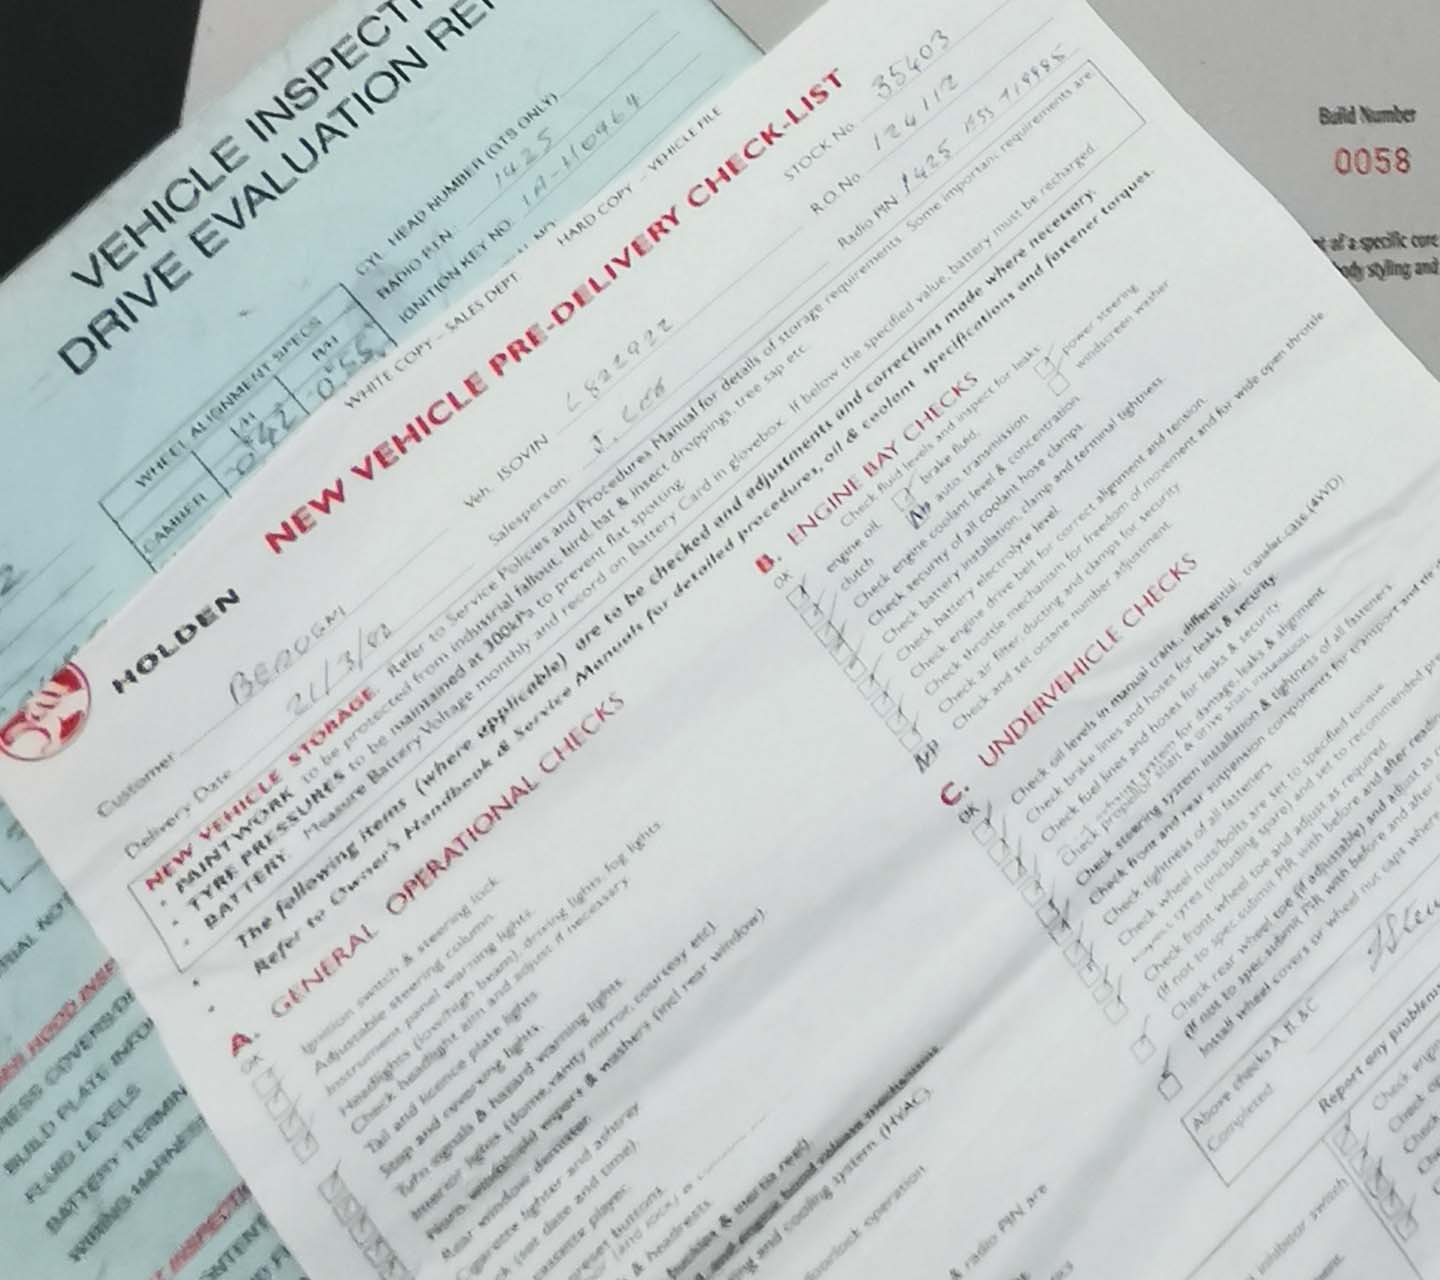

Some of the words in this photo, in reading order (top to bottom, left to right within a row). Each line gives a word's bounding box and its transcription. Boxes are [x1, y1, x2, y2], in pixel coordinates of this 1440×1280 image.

[783, 138, 833, 182] STOCK
[1318, 105, 1357, 126] Build
[1359, 104, 1417, 125] Number
[1334, 146, 1411, 176] 0058
[57, 250, 193, 376] DRIVE
[188, 44, 429, 259] EVALUATION
[70, 135, 249, 289] VEHICLE
[426, 157, 486, 212] NUMBER
[837, 218, 874, 249] Radio
[394, 340, 433, 373] COPY
[556, 213, 597, 246] HARD
[597, 183, 633, 216] COPY
[647, 128, 698, 171] VEHICLE
[398, 266, 462, 324] IGNITION
[459, 240, 488, 269] KEY
[1359, 231, 1408, 253] specific
[1367, 259, 1412, 281] styling
[1415, 257, 1439, 275] and
[264, 477, 346, 555] NEW
[349, 371, 487, 481] VEHICLE
[488, 205, 680, 377] PRE-DELIVERY
[687, 67, 843, 208] CHECK-LIST
[786, 478, 859, 547] ENGINE
[862, 440, 899, 478] BAY
[903, 375, 978, 442] CHECKS
[853, 573, 891, 609] Check
[892, 539, 928, 574] engine
[928, 498, 971, 540] coolant
[967, 471, 997, 501] level
[111, 588, 241, 695] HOLDEN
[977, 629, 1119, 768] UNDERVEHICLE
[1122, 556, 1197, 628] CHECKS
[96, 751, 175, 819] Customer
[123, 804, 191, 860] Delivery
[192, 770, 231, 804] Date
[145, 842, 193, 892] NEW
[198, 769, 281, 841] VEHICLE
[188, 866, 238, 911] TYRE
[240, 771, 346, 867] PRESSURES
[271, 923, 378, 1018] GENERAL
[385, 775, 540, 916] OPERATIONAL
[538, 696, 625, 775] CHECKS
[76, 1084, 141, 1153] LEVELS
